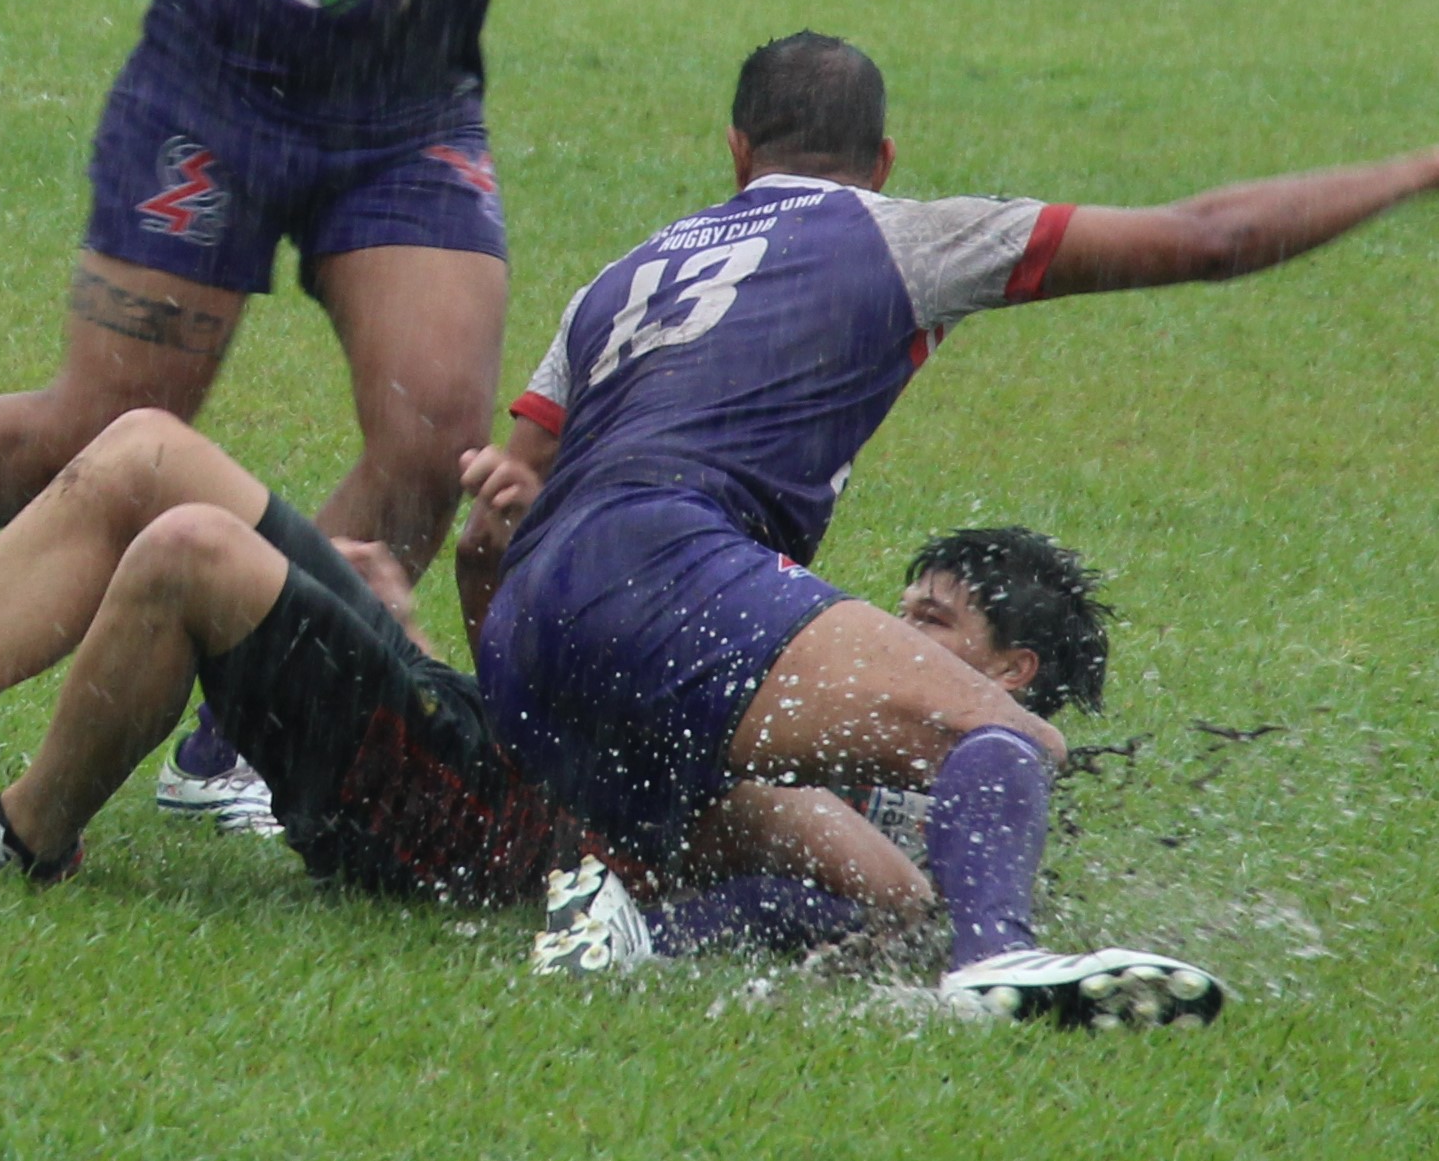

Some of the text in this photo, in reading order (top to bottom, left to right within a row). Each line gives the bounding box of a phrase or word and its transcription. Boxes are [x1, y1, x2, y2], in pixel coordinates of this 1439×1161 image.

[657, 216, 779, 253] RUGBY CLUB
[588, 237, 768, 387] 13
